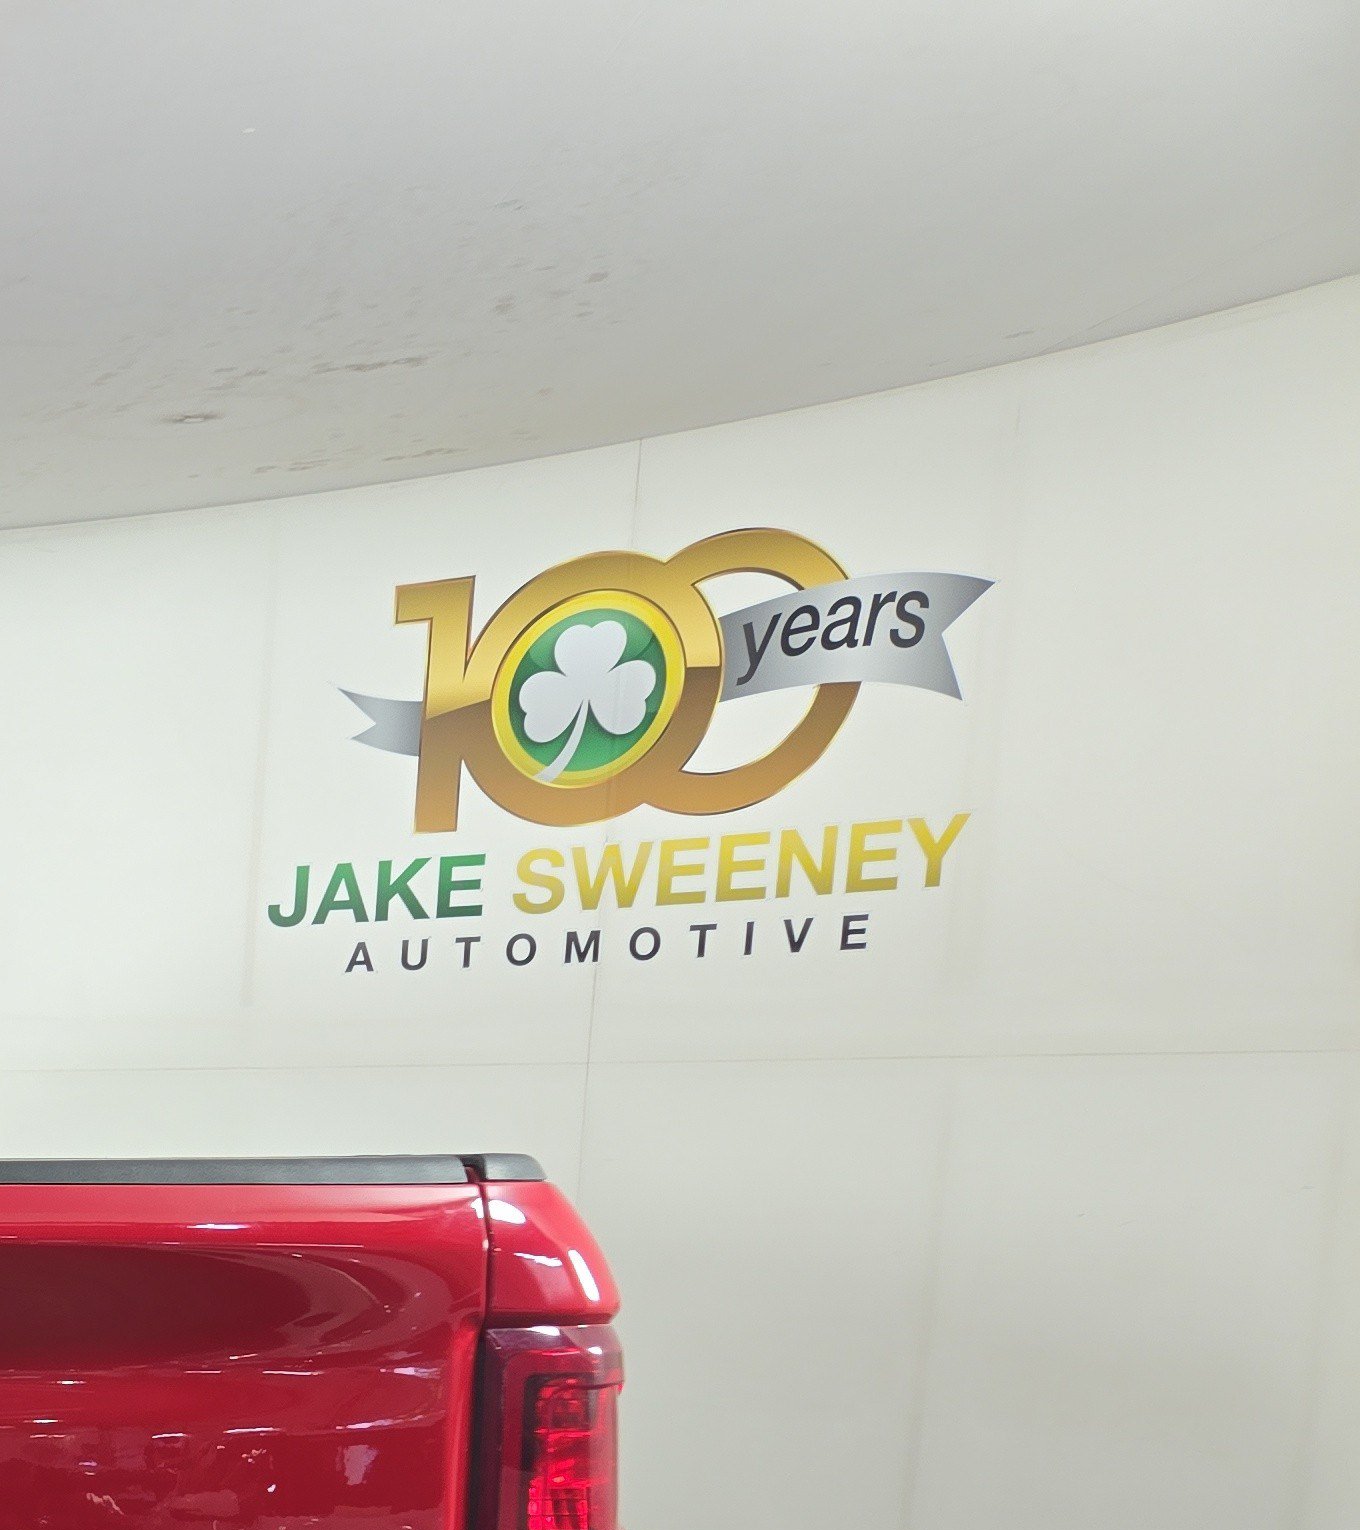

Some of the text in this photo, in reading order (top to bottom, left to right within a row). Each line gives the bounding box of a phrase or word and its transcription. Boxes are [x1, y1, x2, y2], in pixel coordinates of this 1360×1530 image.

[393, 526, 863, 834] 100
[735, 586, 930, 686] years
[267, 812, 971, 928] JAKE SWEENEY
[344, 913, 870, 974] AUTOMOTIVE
